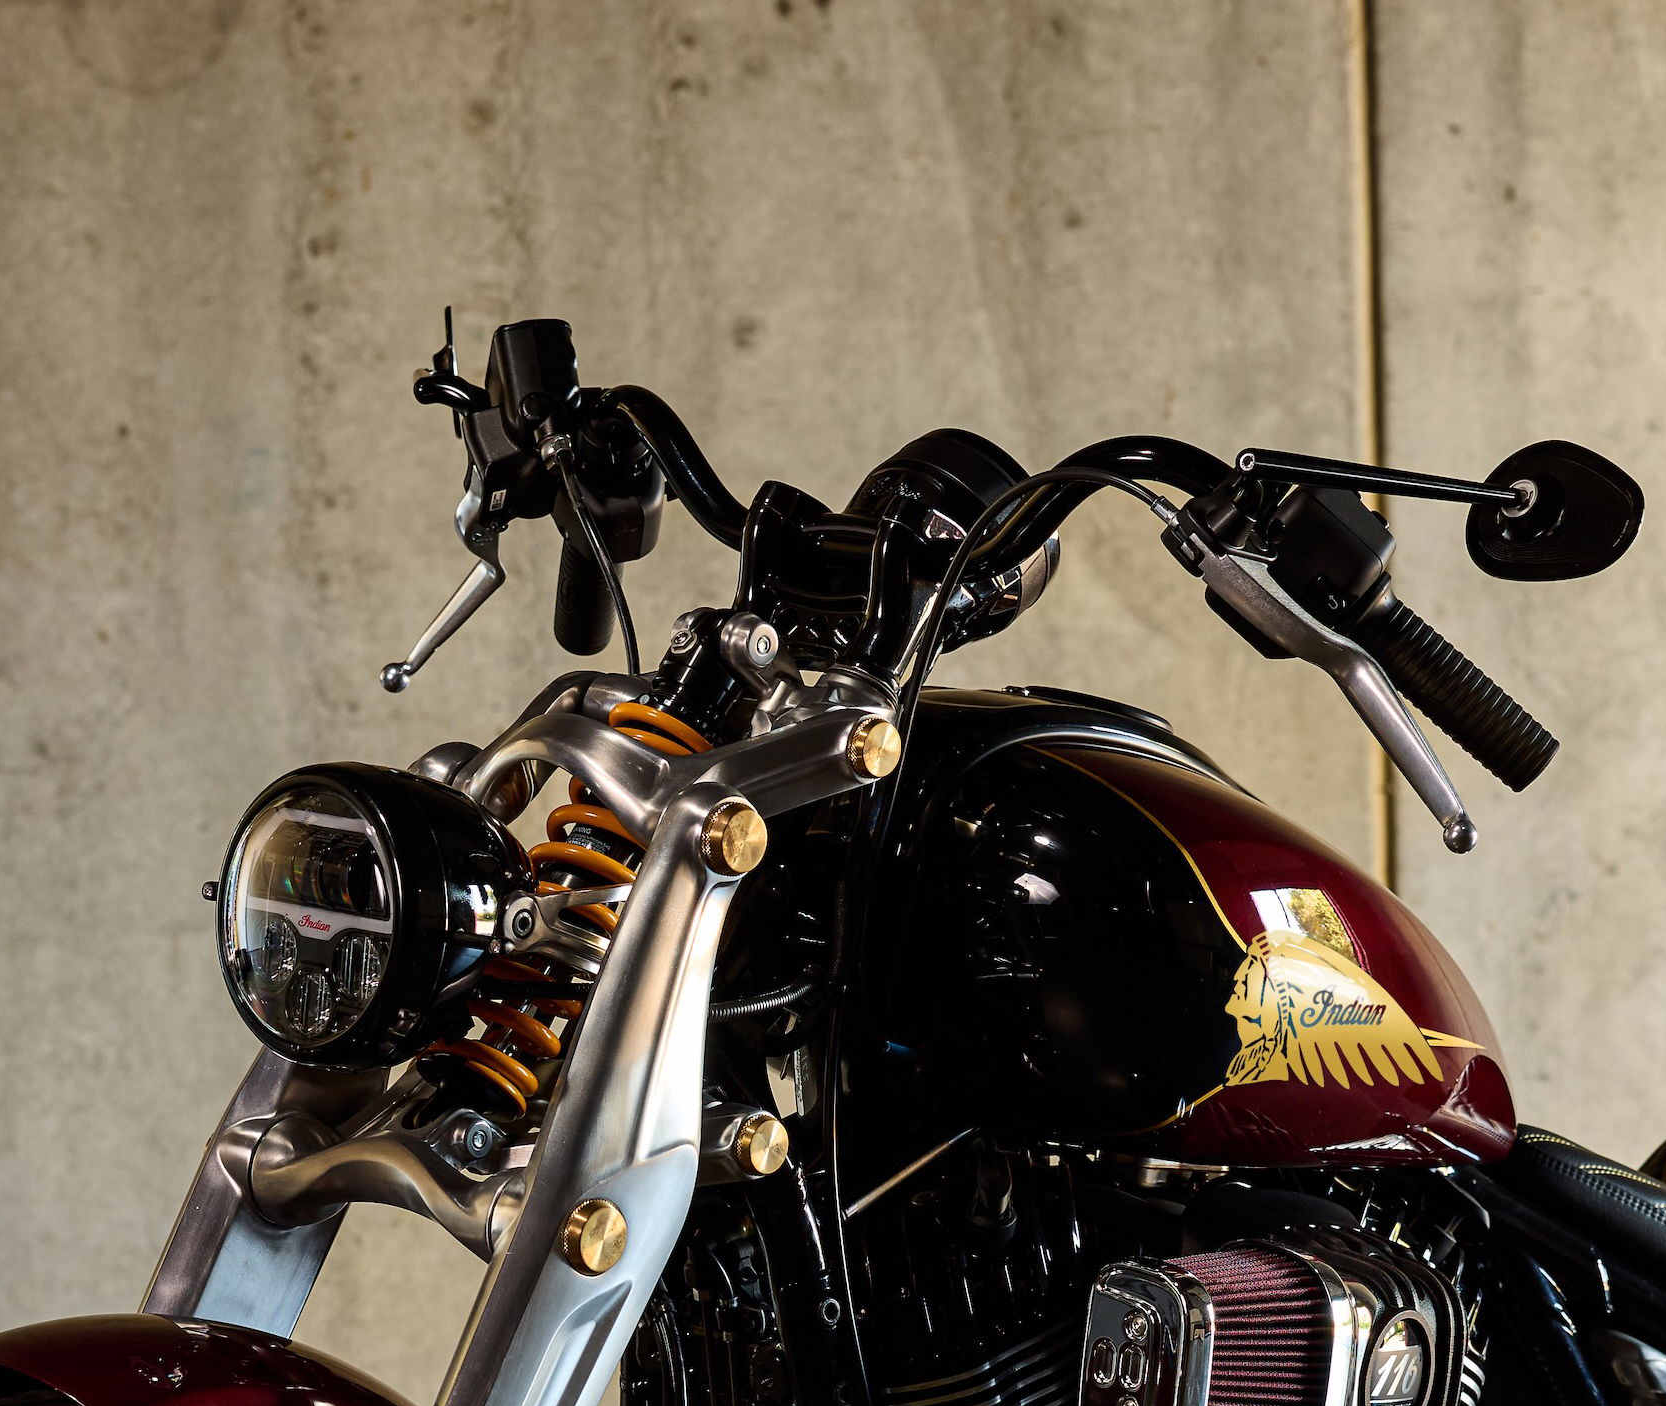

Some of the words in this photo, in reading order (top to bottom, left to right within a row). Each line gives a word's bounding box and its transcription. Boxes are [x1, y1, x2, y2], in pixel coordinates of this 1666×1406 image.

[298, 914, 331, 932] Indian
[1300, 986, 1387, 1028] Indian
[1370, 1353, 1422, 1397] 116
